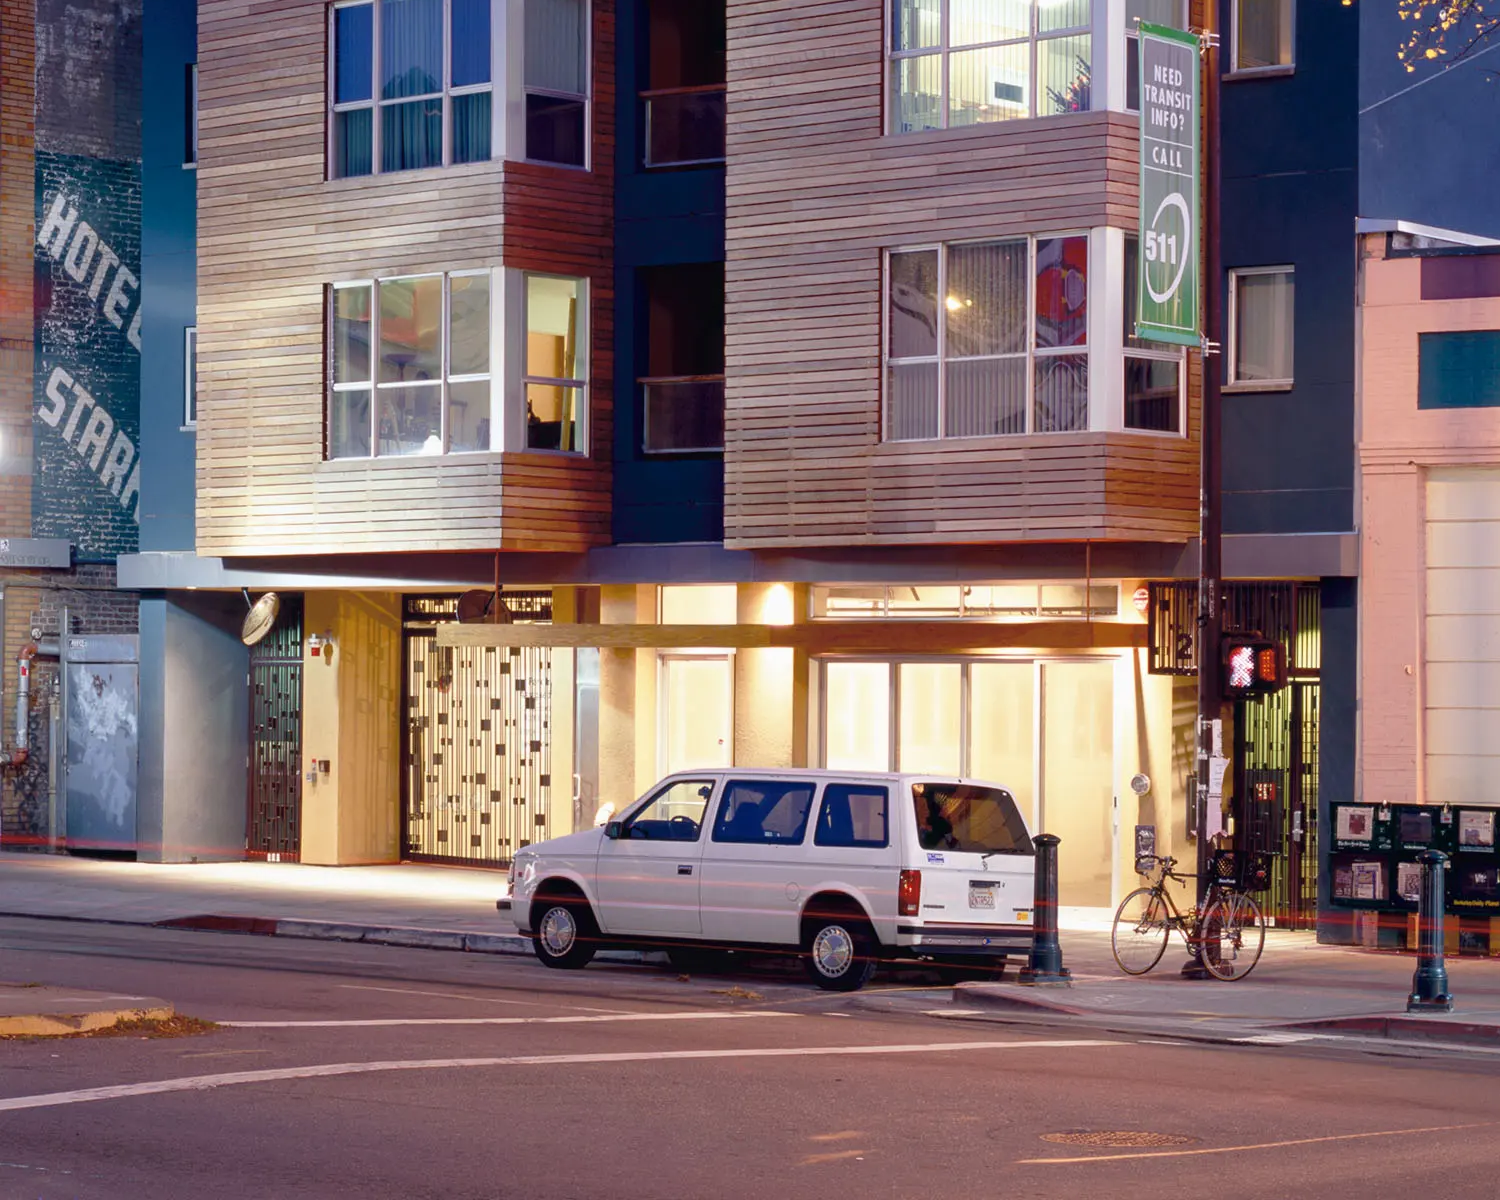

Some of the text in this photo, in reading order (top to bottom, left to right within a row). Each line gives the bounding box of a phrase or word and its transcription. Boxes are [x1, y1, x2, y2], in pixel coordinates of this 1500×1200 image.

[1154, 64, 1182, 86] NEED
[1144, 84, 1191, 111] TRANSIT
[1151, 107, 1184, 131] INFO?
[1152, 146, 1182, 168] CALL
[1145, 229, 1176, 265] 511
[38, 192, 141, 353] HOTE
